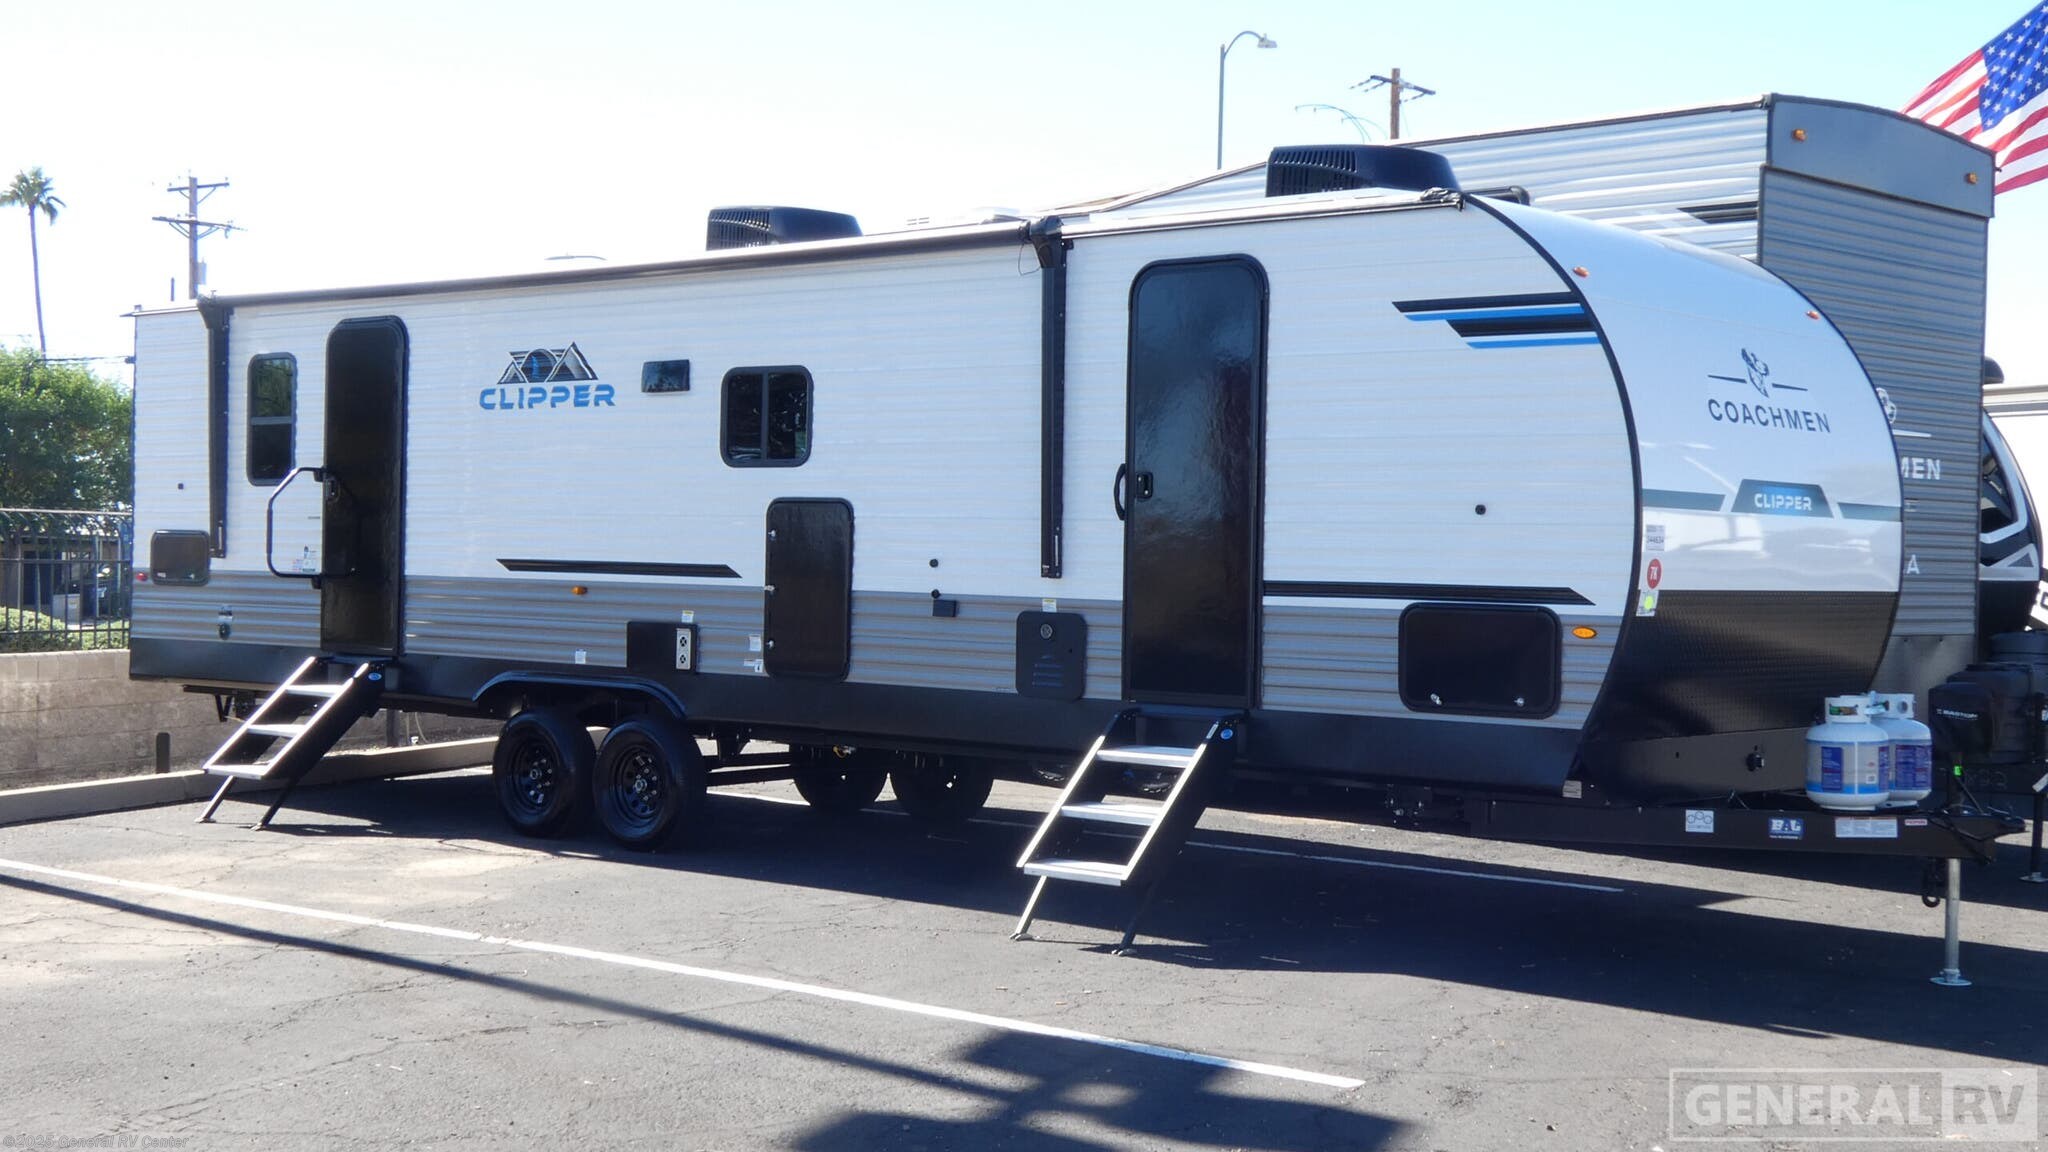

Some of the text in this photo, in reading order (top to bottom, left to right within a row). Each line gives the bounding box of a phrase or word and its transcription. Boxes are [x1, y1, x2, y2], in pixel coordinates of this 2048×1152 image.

[479, 384, 616, 410] CLIPPER
[1708, 398, 1831, 433] COACHMEN
[1754, 493, 1812, 511] CLIPPER
